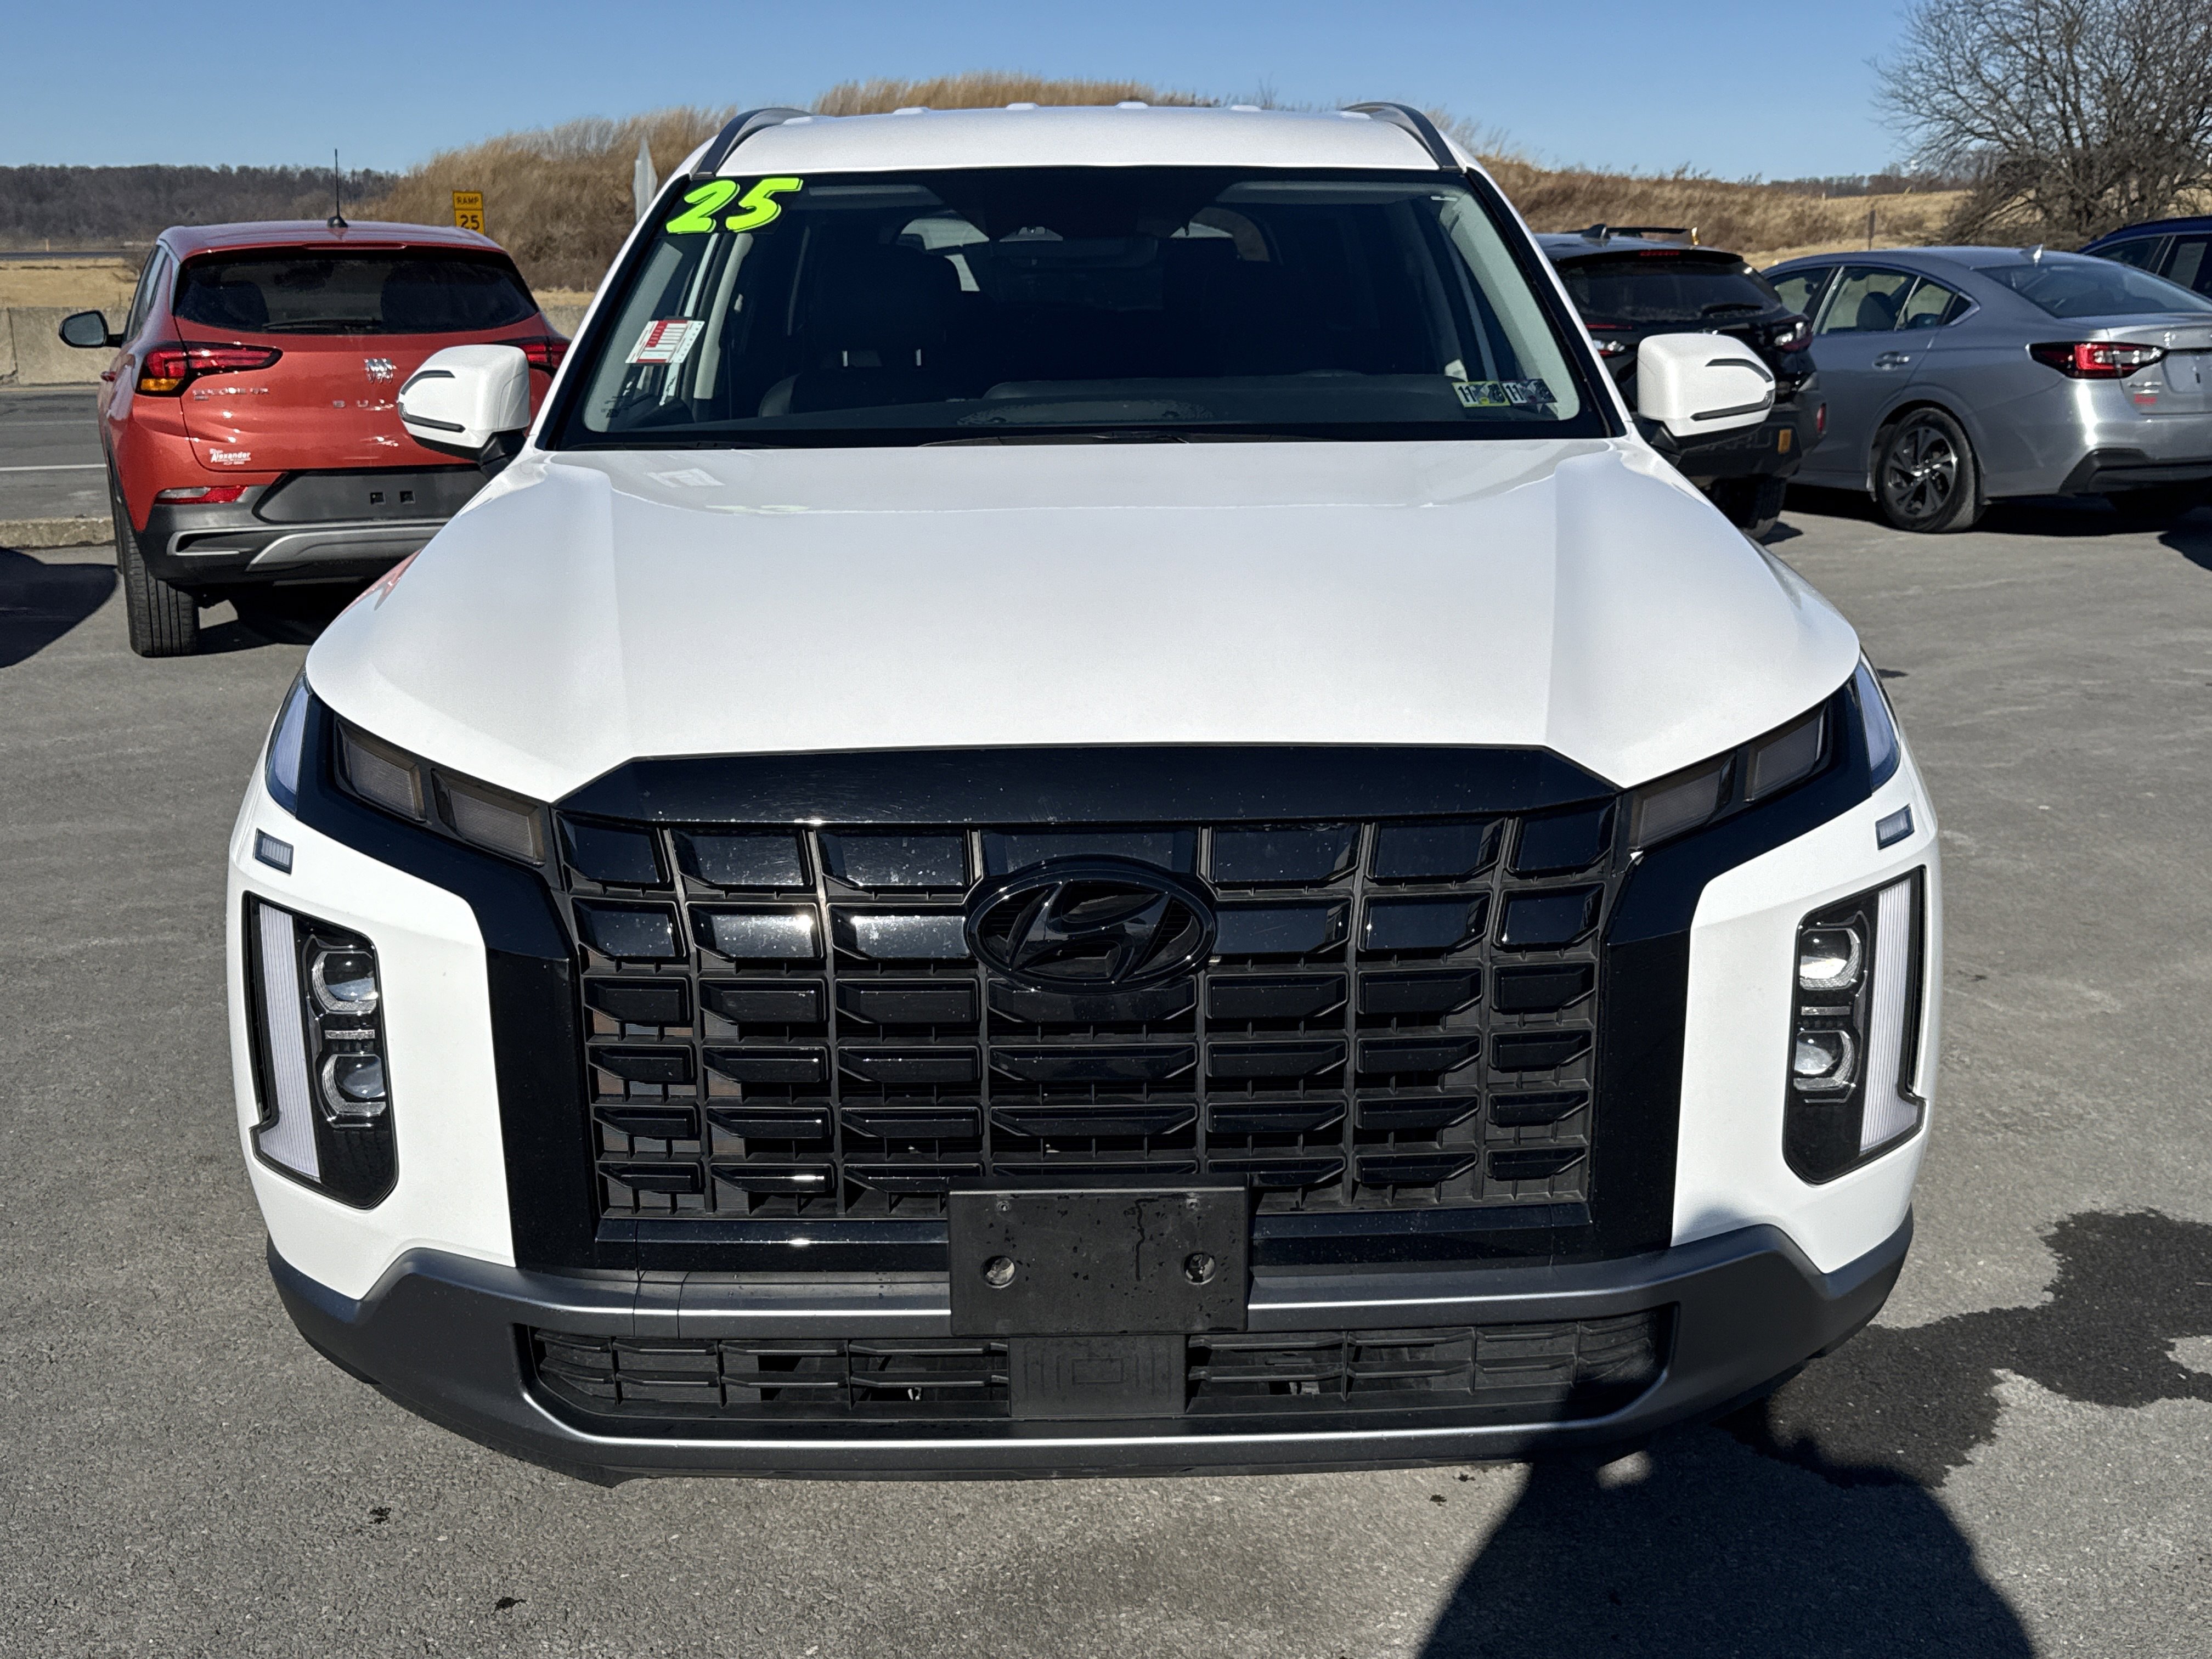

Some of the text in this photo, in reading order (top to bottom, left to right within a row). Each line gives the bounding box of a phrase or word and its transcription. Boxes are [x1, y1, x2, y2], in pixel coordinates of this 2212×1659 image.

[456, 196, 479, 204] RAMP
[666, 177, 804, 234] 25
[460, 214, 480, 230] 25
